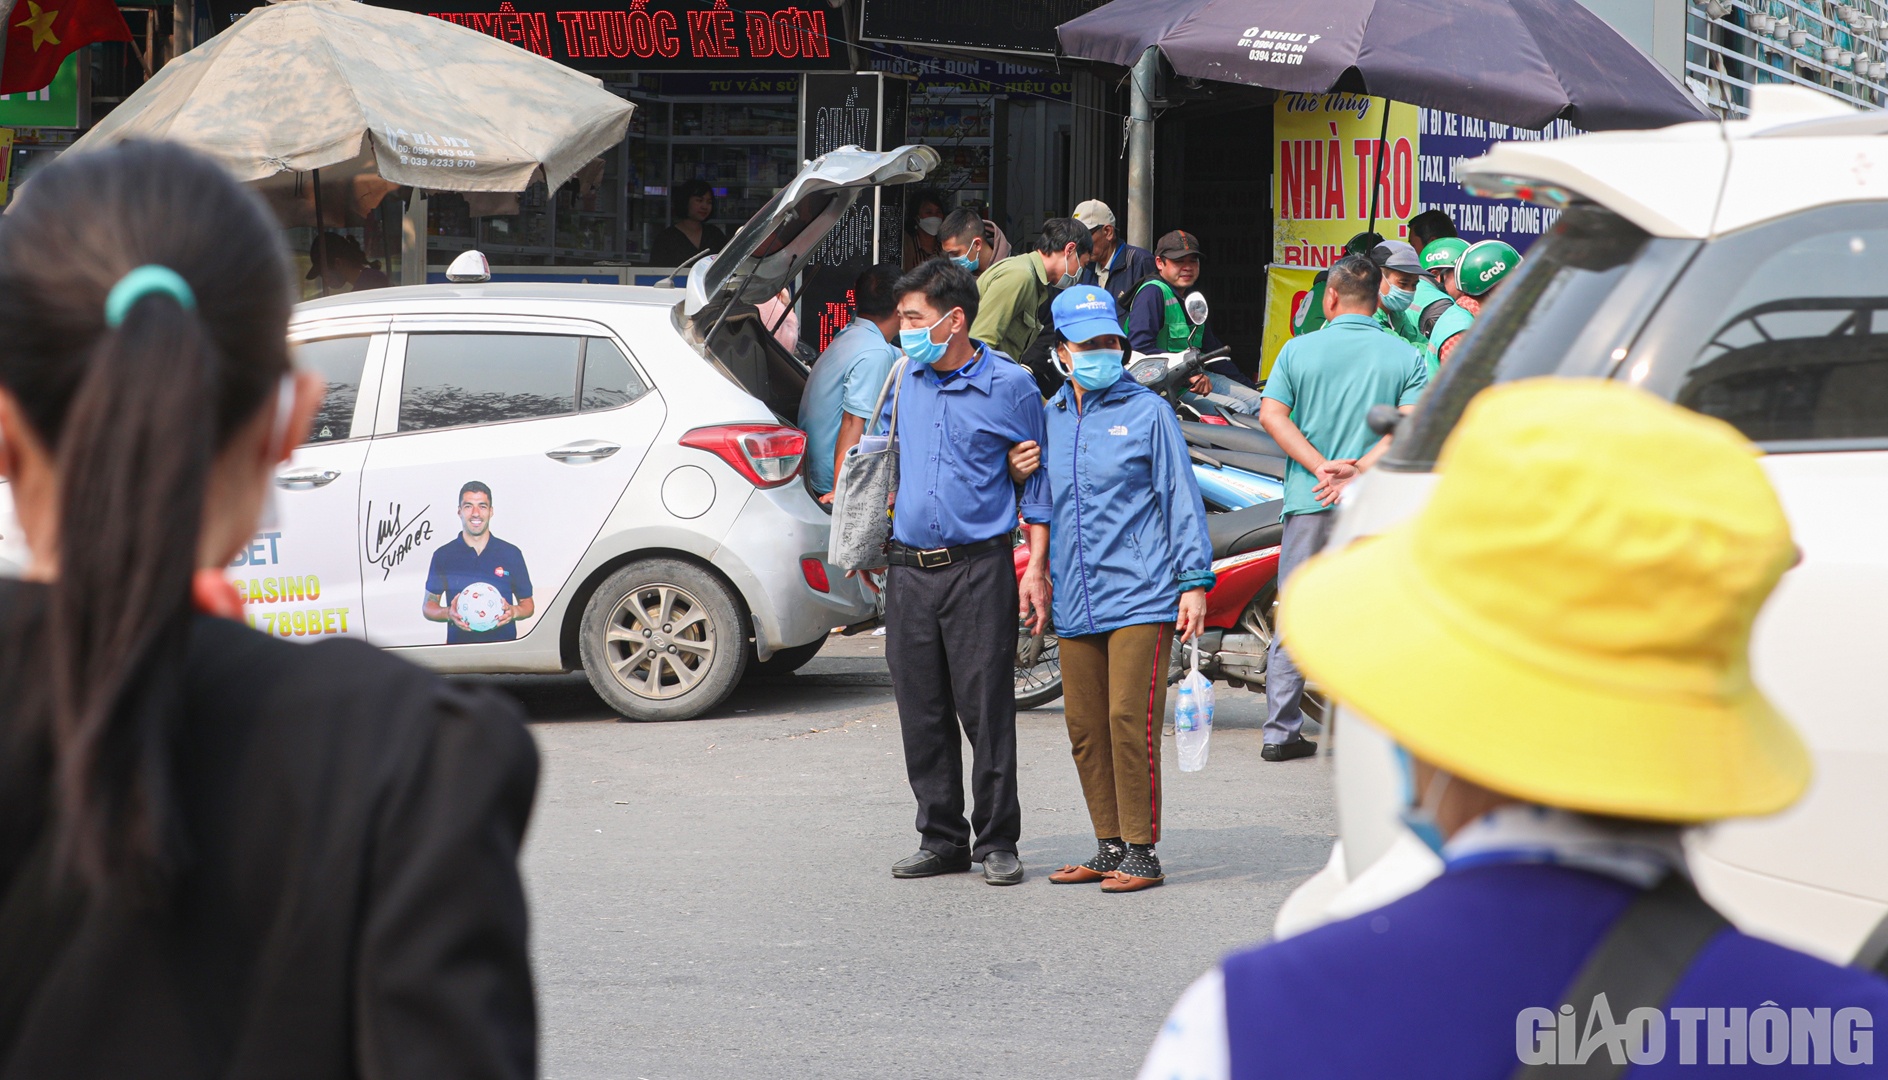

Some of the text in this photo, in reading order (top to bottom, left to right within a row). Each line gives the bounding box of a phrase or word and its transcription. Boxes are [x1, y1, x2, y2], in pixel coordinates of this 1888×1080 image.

[556, 0, 680, 58] THUỐC
[746, 7, 830, 58] ĐƠN
[1260, 30, 1306, 41] NHƯ
[1249, 50, 1303, 64] 0394 233 670
[1274, 42, 1291, 51] 043
[1291, 44, 1307, 53] 044
[709, 80, 732, 92] TƯ
[736, 76, 772, 92] VẤN
[1444, 111, 1458, 136] XE
[410, 157, 428, 166] 039
[457, 159, 476, 168] 670
[1280, 121, 1413, 237] NHÀ TRỌ
[1459, 203, 1486, 235] TAXI,
[1488, 203, 1510, 239] HỢP
[1425, 250, 1450, 262] Grab
[1480, 261, 1506, 282] Grab
[232, 575, 320, 606] CASINO
[262, 607, 350, 638] 789BET
